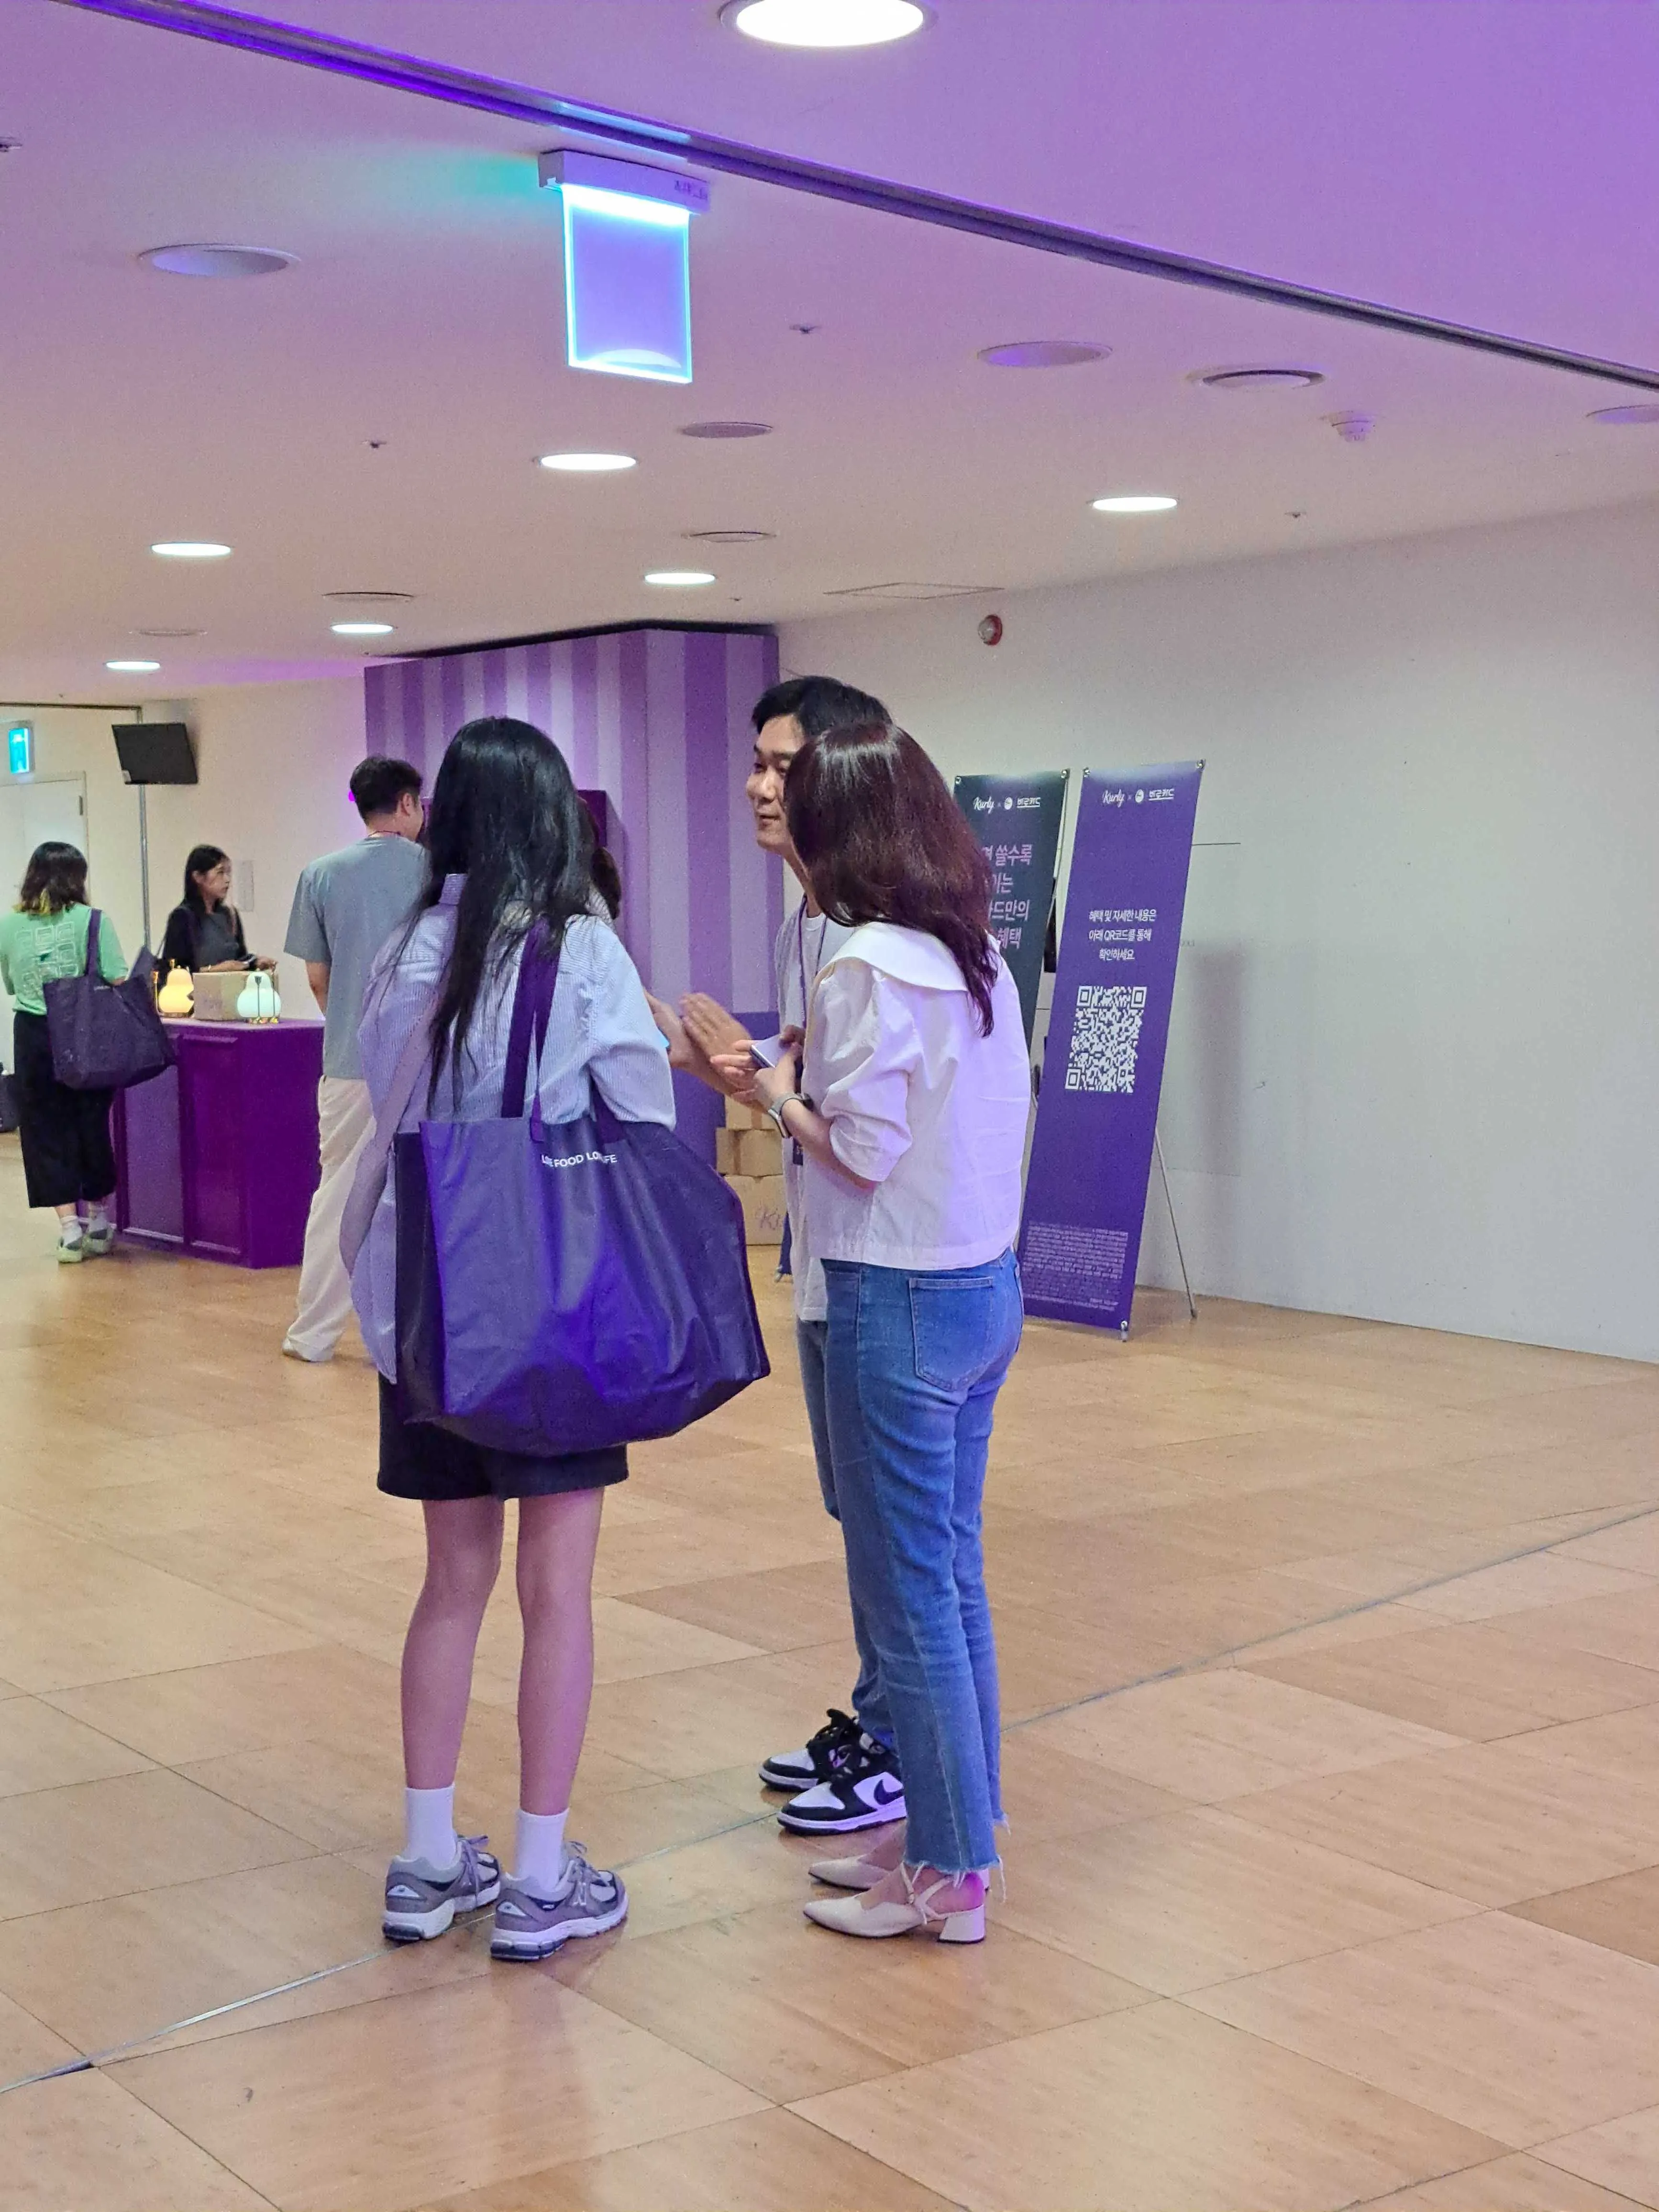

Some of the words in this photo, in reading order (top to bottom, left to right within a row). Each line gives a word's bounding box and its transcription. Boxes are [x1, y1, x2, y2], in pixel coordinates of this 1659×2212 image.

[1102, 789, 1125, 807] Kurly
[973, 796, 995, 814] Kurly
[995, 844, 1032, 866] 쓸수록
[1089, 909, 1103, 922] 혜택
[1105, 909, 1112, 922] 및
[1112, 909, 1134, 922] 자세한
[1135, 909, 1156, 922] 내용은
[1089, 929, 1104, 941] 아래
[1104, 929, 1136, 941] QR코드를
[1137, 928, 1152, 941] 통해
[1099, 948, 1135, 961] 확인하세요
[554, 1154, 584, 1167] FOOD
